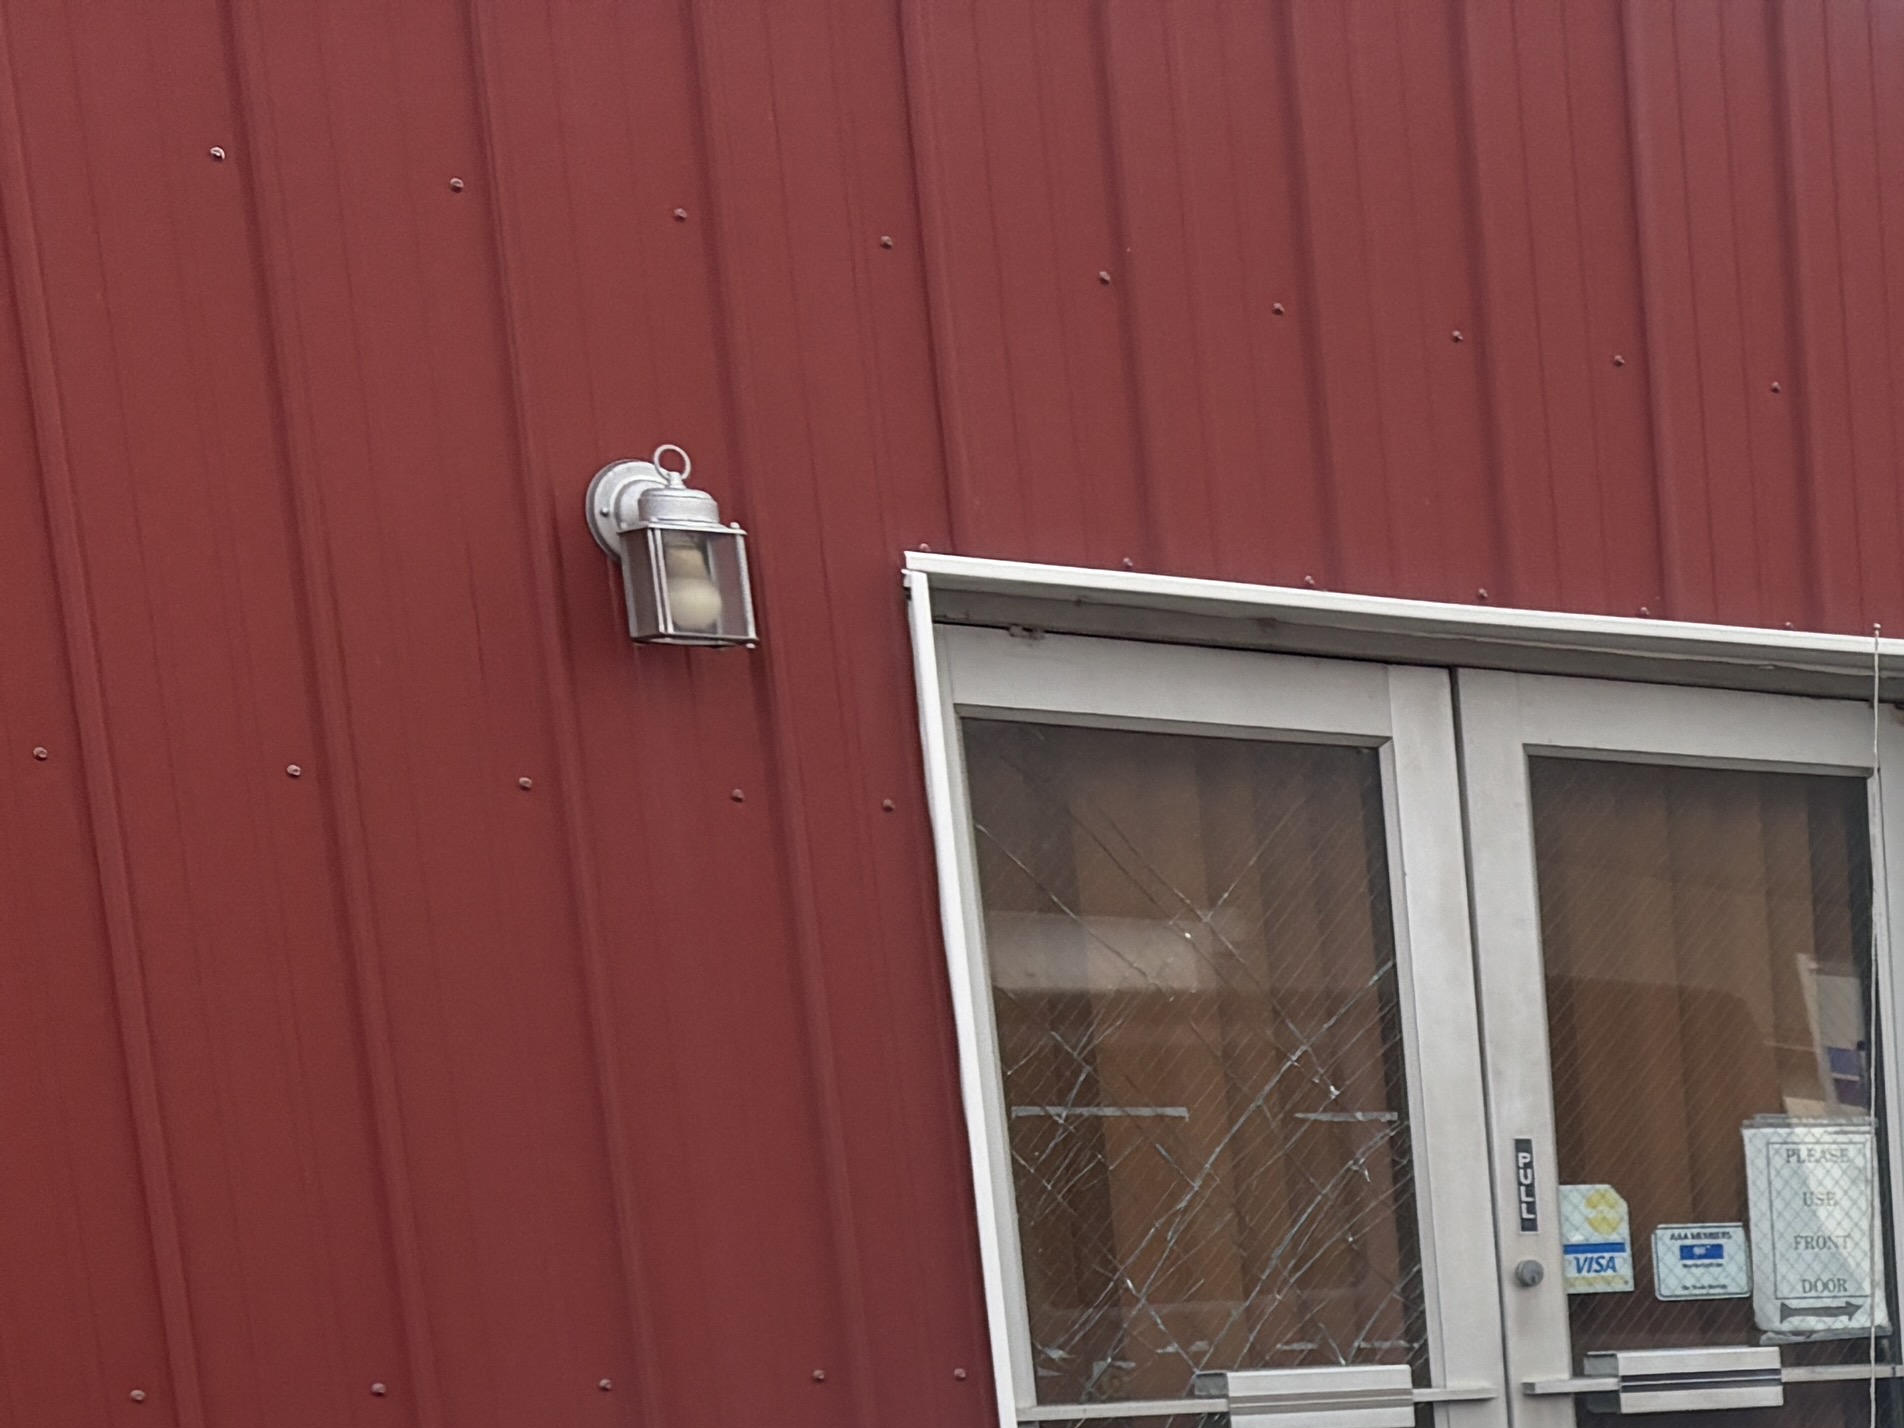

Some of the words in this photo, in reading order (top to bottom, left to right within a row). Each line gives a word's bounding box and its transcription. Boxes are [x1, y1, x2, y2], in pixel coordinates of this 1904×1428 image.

[1786, 1148, 1850, 1164] PLEASE
[1517, 1152, 1535, 1220] PULL
[1803, 1191, 1838, 1207] USE
[1794, 1235, 1851, 1250] FRONT
[1574, 1256, 1617, 1274] VISA
[1802, 1278, 1848, 1293] DOOR
